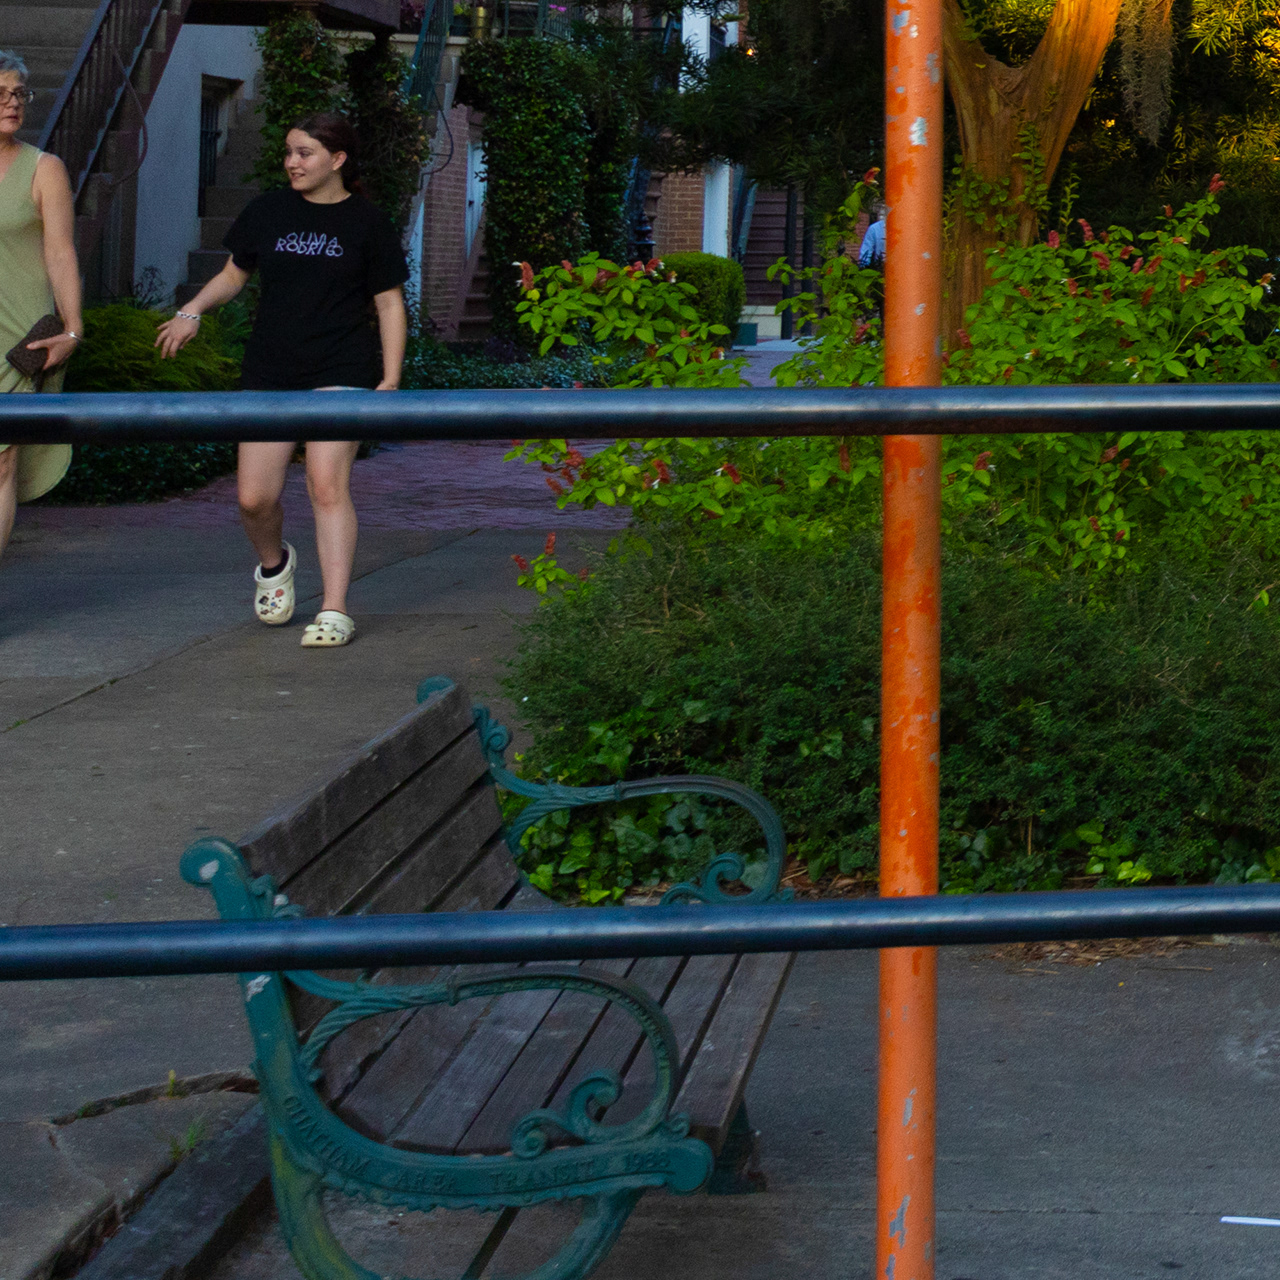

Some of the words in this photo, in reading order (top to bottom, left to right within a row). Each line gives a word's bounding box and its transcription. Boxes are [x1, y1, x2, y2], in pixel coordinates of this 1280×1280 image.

[275, 238, 343, 257] RODRIGO
[283, 1096, 372, 1174] CHATHAM
[490, 1158, 596, 1192] TRANSIT
